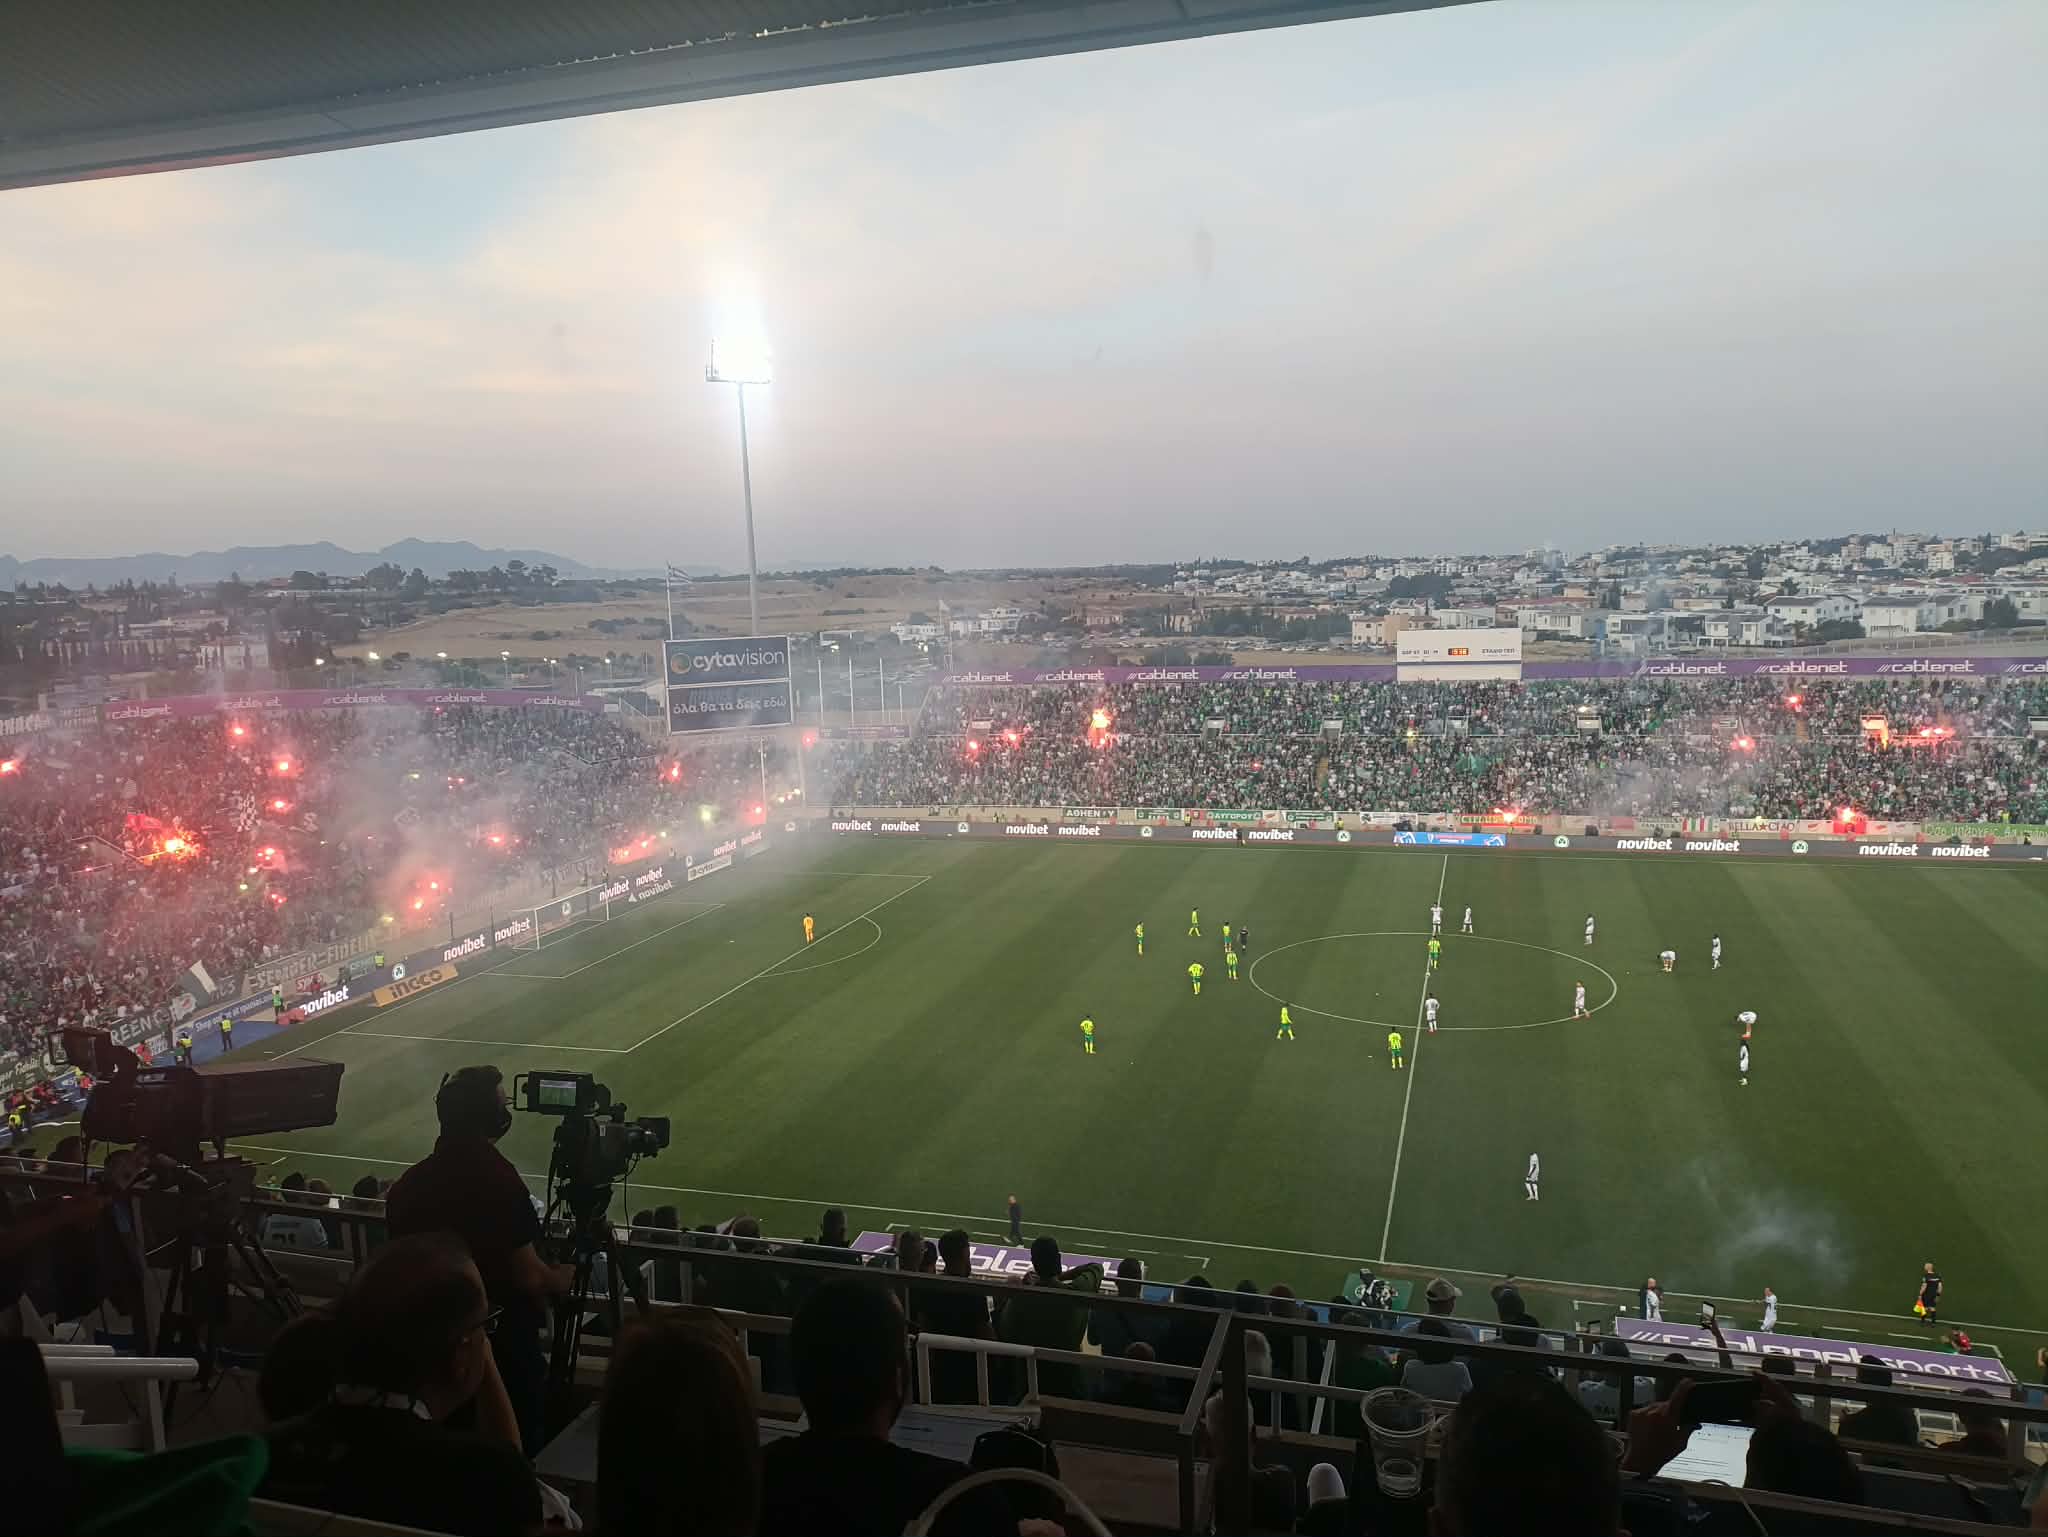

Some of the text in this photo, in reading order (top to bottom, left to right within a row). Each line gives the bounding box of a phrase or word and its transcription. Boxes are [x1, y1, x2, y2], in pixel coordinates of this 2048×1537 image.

[692, 648, 785, 671] cytavision
[1891, 659, 1975, 672] cablenet
[1650, 661, 1727, 674] cablenet
[1768, 660, 1848, 673] cablenet
[952, 671, 1014, 683] cablenet
[1046, 669, 1105, 681] cablenet
[1137, 668, 1200, 680] cablenet
[1233, 667, 1297, 679] cablenet
[832, 820, 872, 831] novibet
[881, 822, 920, 832] novibet
[1006, 824, 1048, 834] novibet
[1059, 825, 1100, 836] novibet
[1192, 828, 1238, 839] novibet
[1249, 829, 1294, 840] novibet
[1617, 838, 1673, 850] novibet
[1685, 839, 1740, 851] novibet
[1859, 843, 1918, 856] novibet
[1932, 845, 1990, 857] novibet
[635, 867, 663, 887] novibet
[599, 879, 629, 901] novibet
[638, 880, 673, 900] novibet
[494, 918, 530, 942] novibet
[443, 933, 485, 961] novibet
